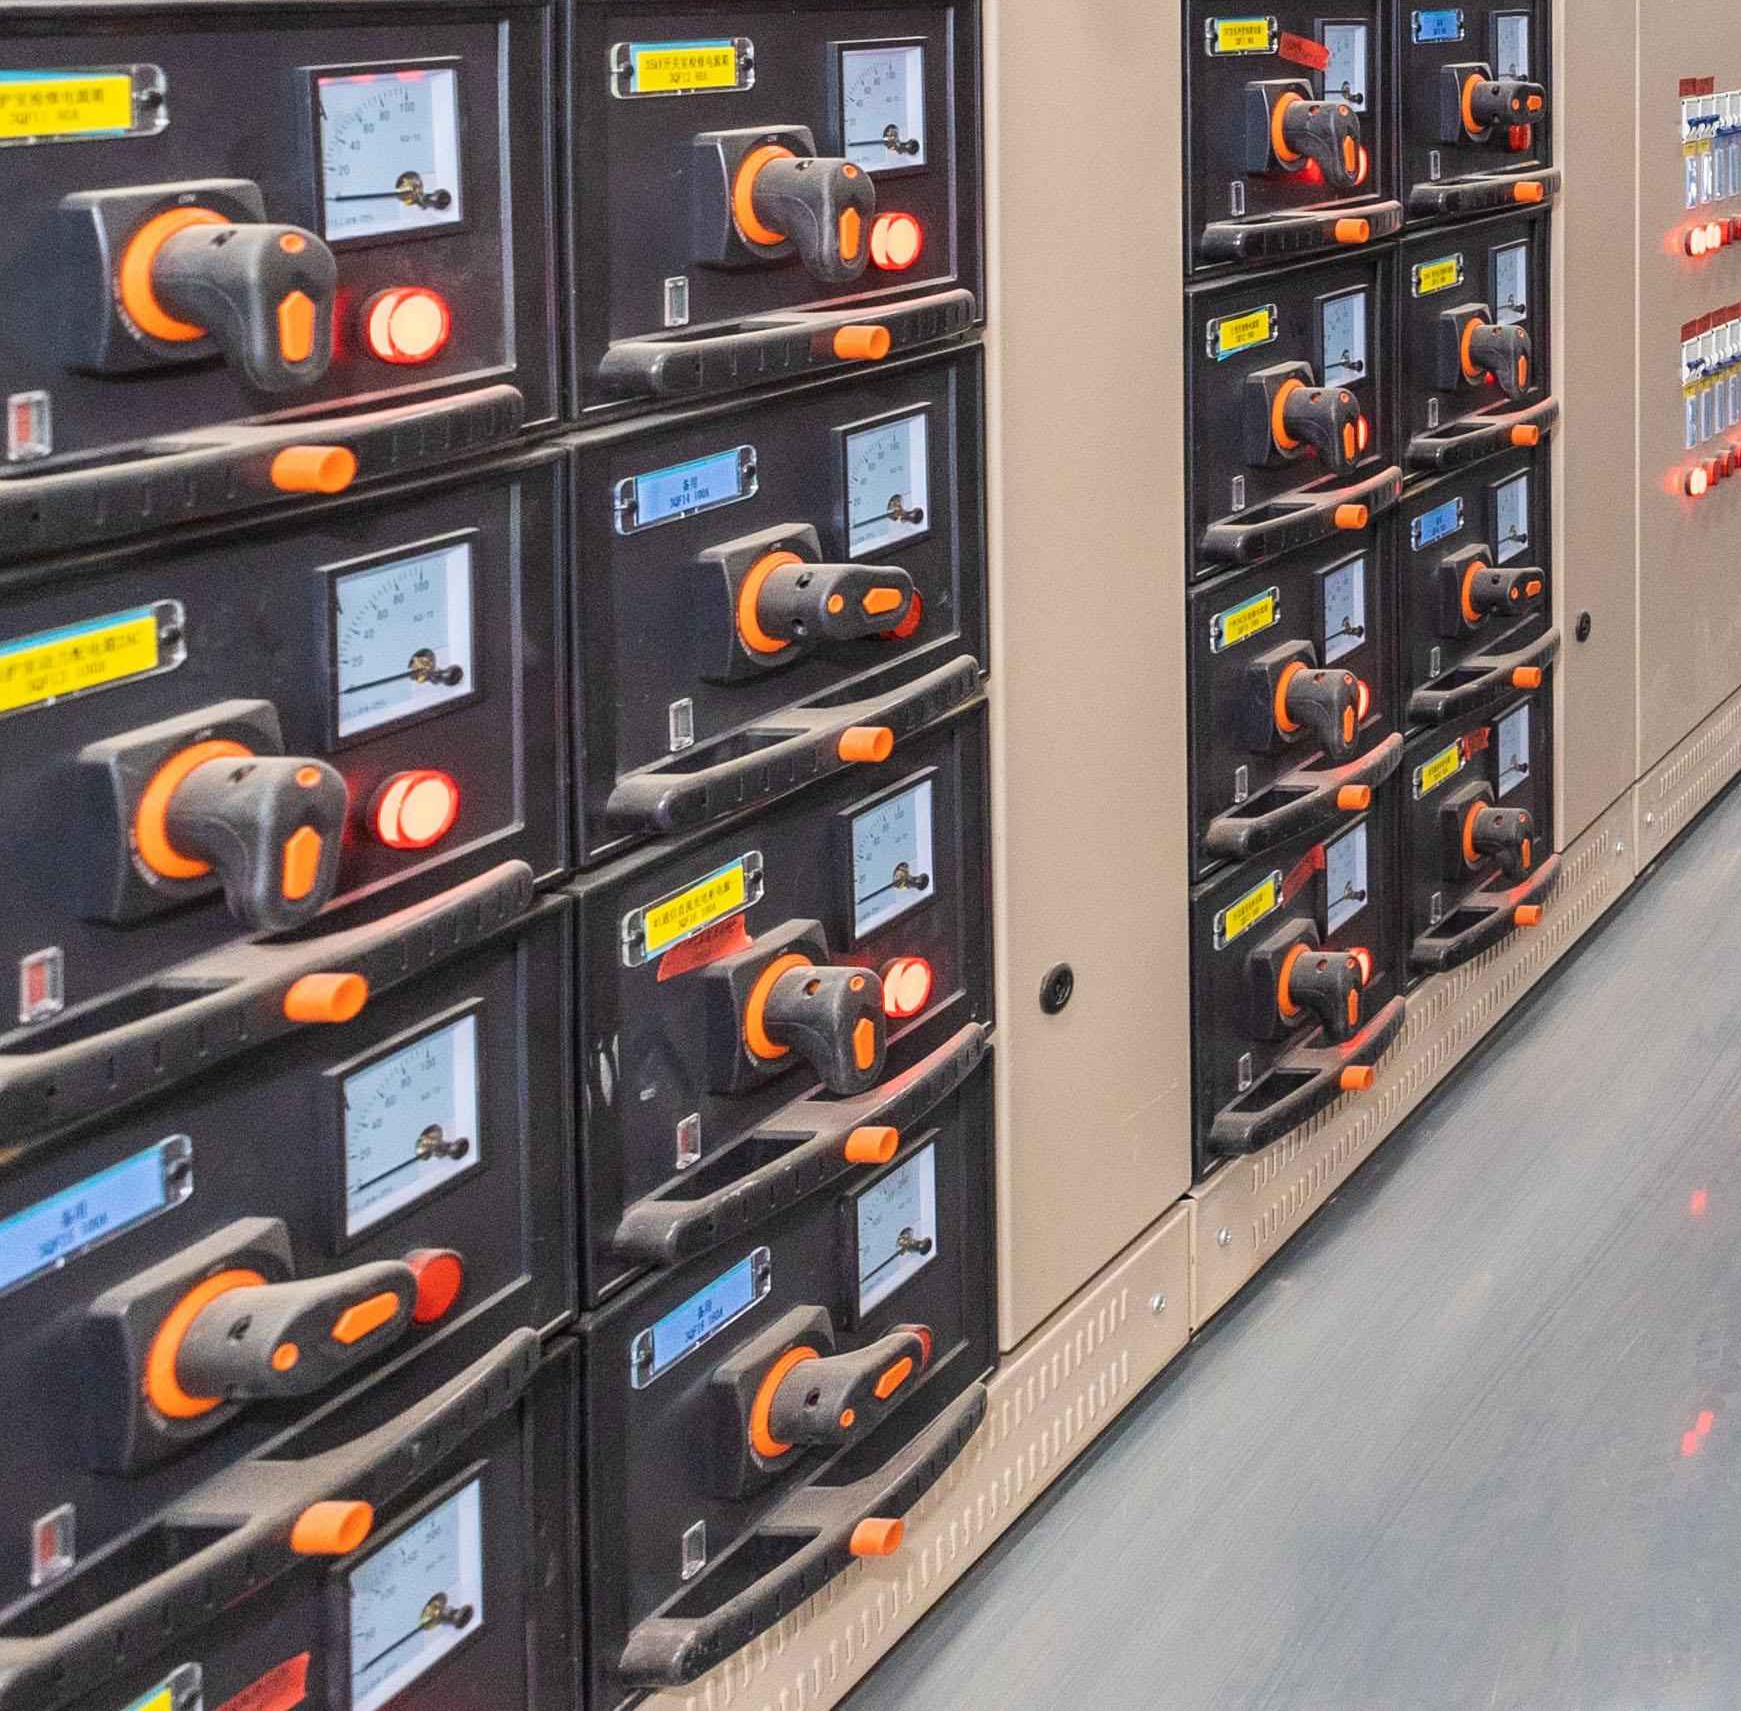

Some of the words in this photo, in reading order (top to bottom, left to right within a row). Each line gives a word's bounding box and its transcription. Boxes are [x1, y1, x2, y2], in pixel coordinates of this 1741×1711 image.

[399, 101, 415, 114] 100
[379, 110, 390, 122] 80
[363, 122, 375, 134] 60
[349, 139, 361, 151] 40
[338, 164, 350, 176] 20
